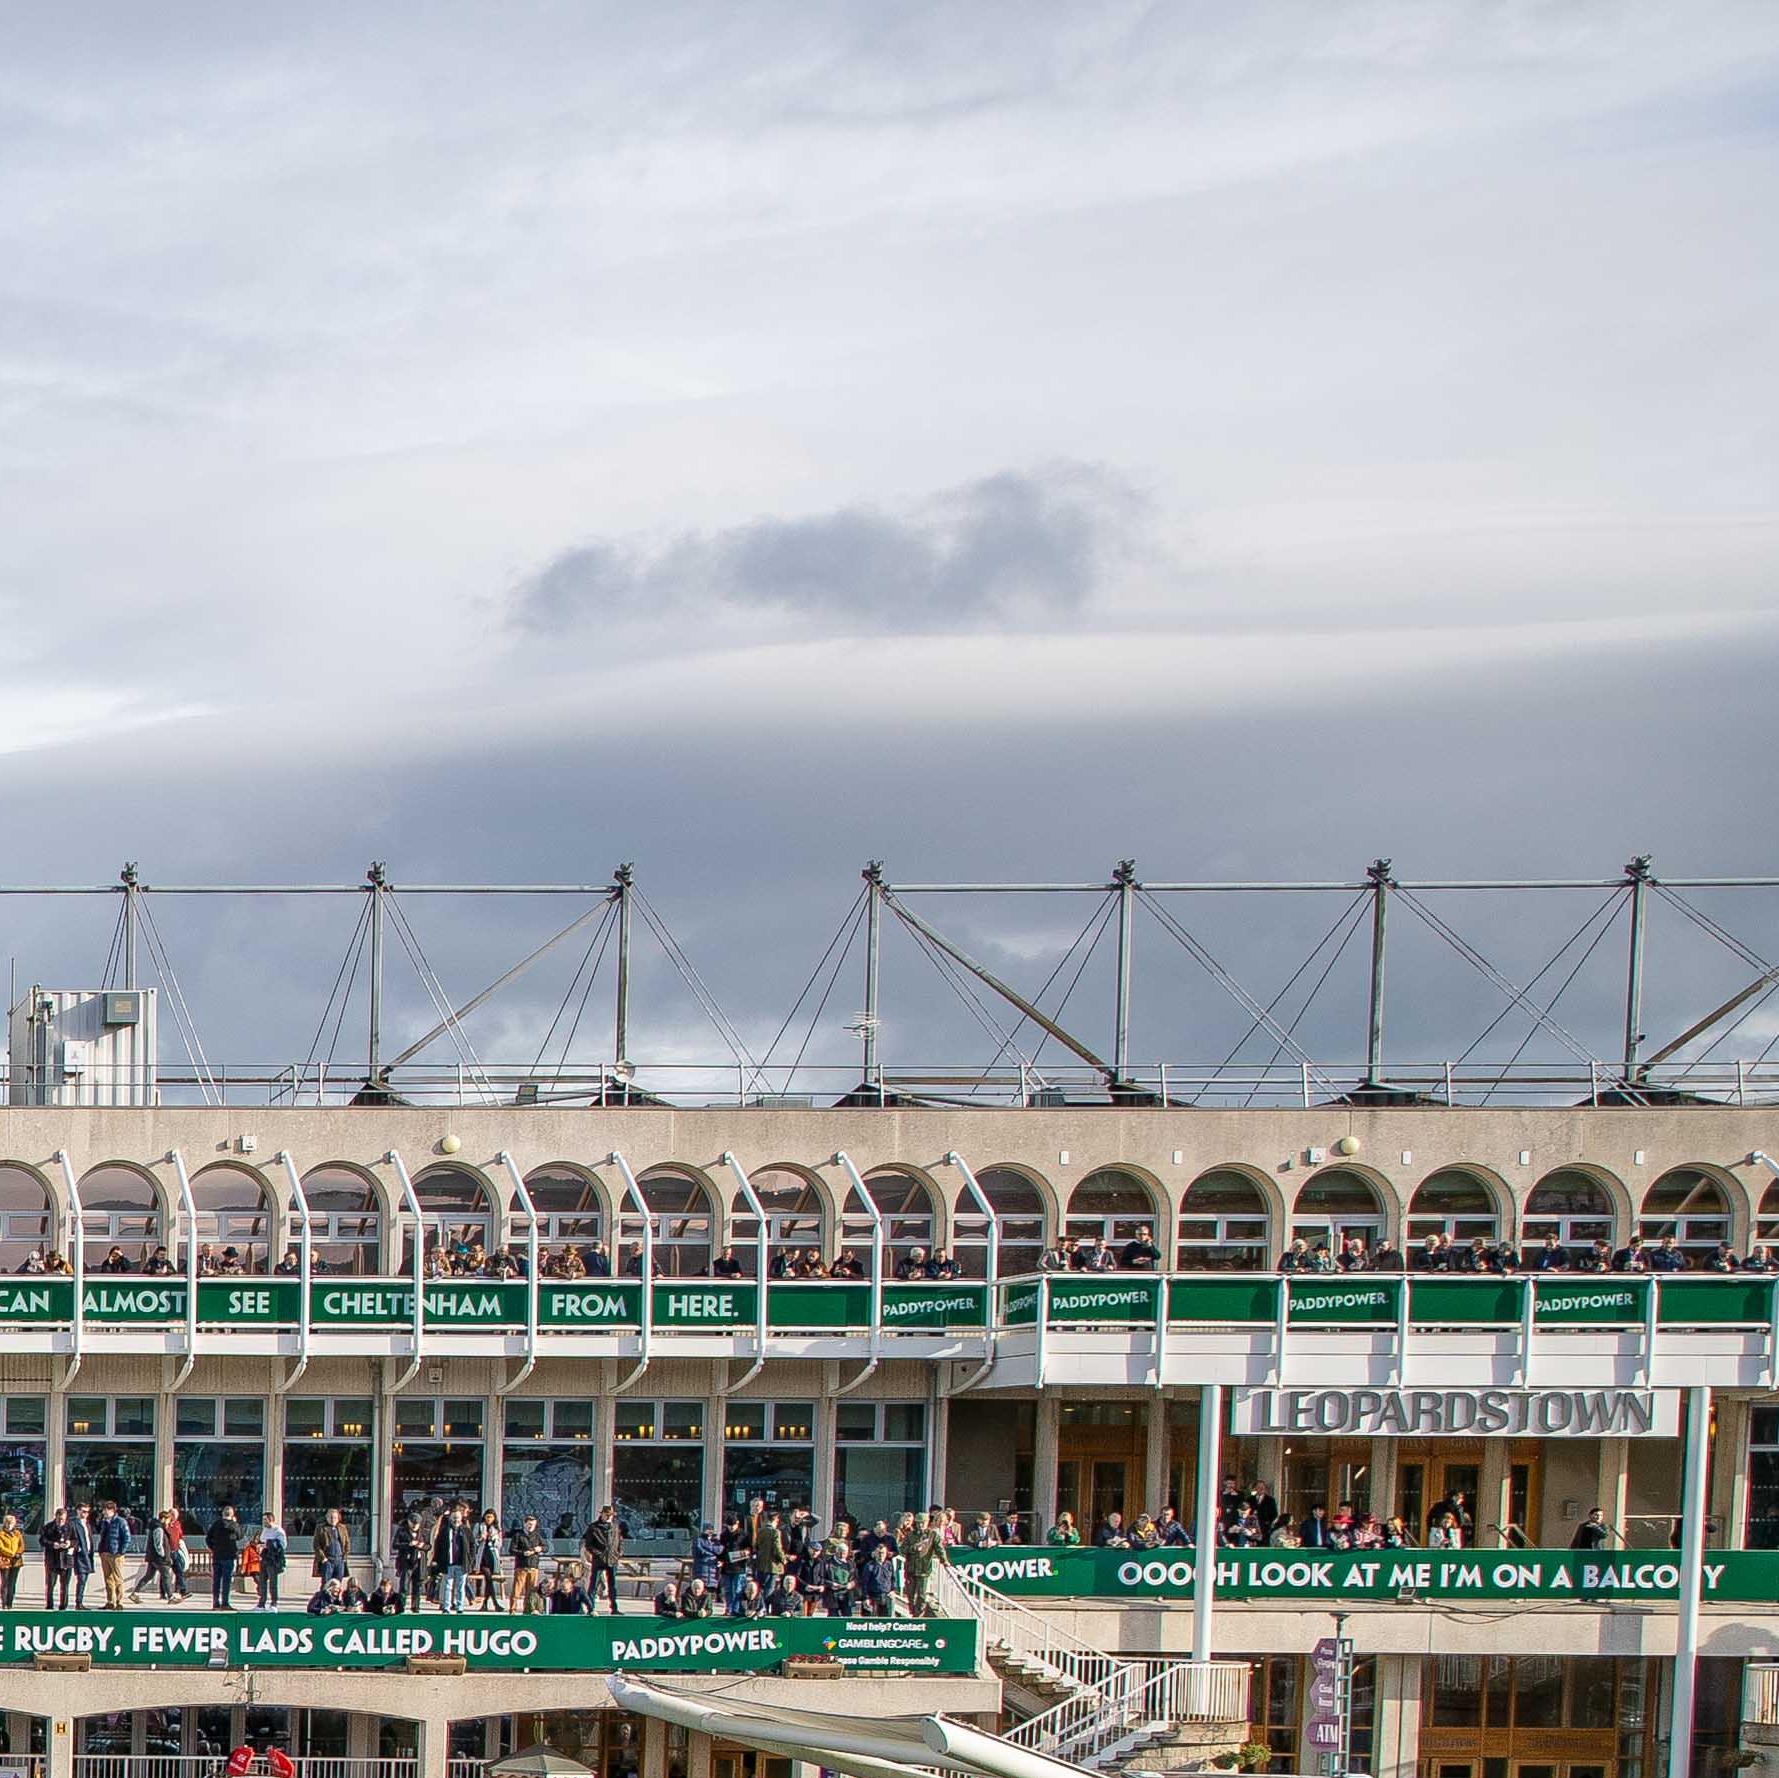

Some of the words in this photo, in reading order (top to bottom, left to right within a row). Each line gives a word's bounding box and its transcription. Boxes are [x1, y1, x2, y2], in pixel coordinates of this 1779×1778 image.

[83, 1290, 187, 1313] ALMOST
[228, 1292, 271, 1315] SEE
[552, 1294, 627, 1318] FROM
[669, 1294, 740, 1318] HERE.
[1258, 1388, 1656, 1434] LEOPARDSTOWN
[1249, 1562, 1334, 1587] LOOK
[1343, 1563, 1381, 1587] AT
[1387, 1563, 1431, 1588] ME
[1440, 1563, 1483, 1588] I'M
[1492, 1563, 1542, 1588] ON
[1551, 1564, 1574, 1588] A
[1582, 1563, 1725, 1589] BALCOY
[14, 1625, 122, 1656] RUGBY,
[132, 1626, 229, 1653] FEWER
[239, 1627, 314, 1655] LADS
[323, 1627, 433, 1655] CALLED
[442, 1628, 539, 1656] HUGO
[846, 1622, 868, 1632] Need
[869, 1622, 892, 1633] help?
[893, 1622, 927, 1632] Contact
[858, 1655, 890, 1665] Gamble
[890, 1655, 941, 1667] Responsibly
